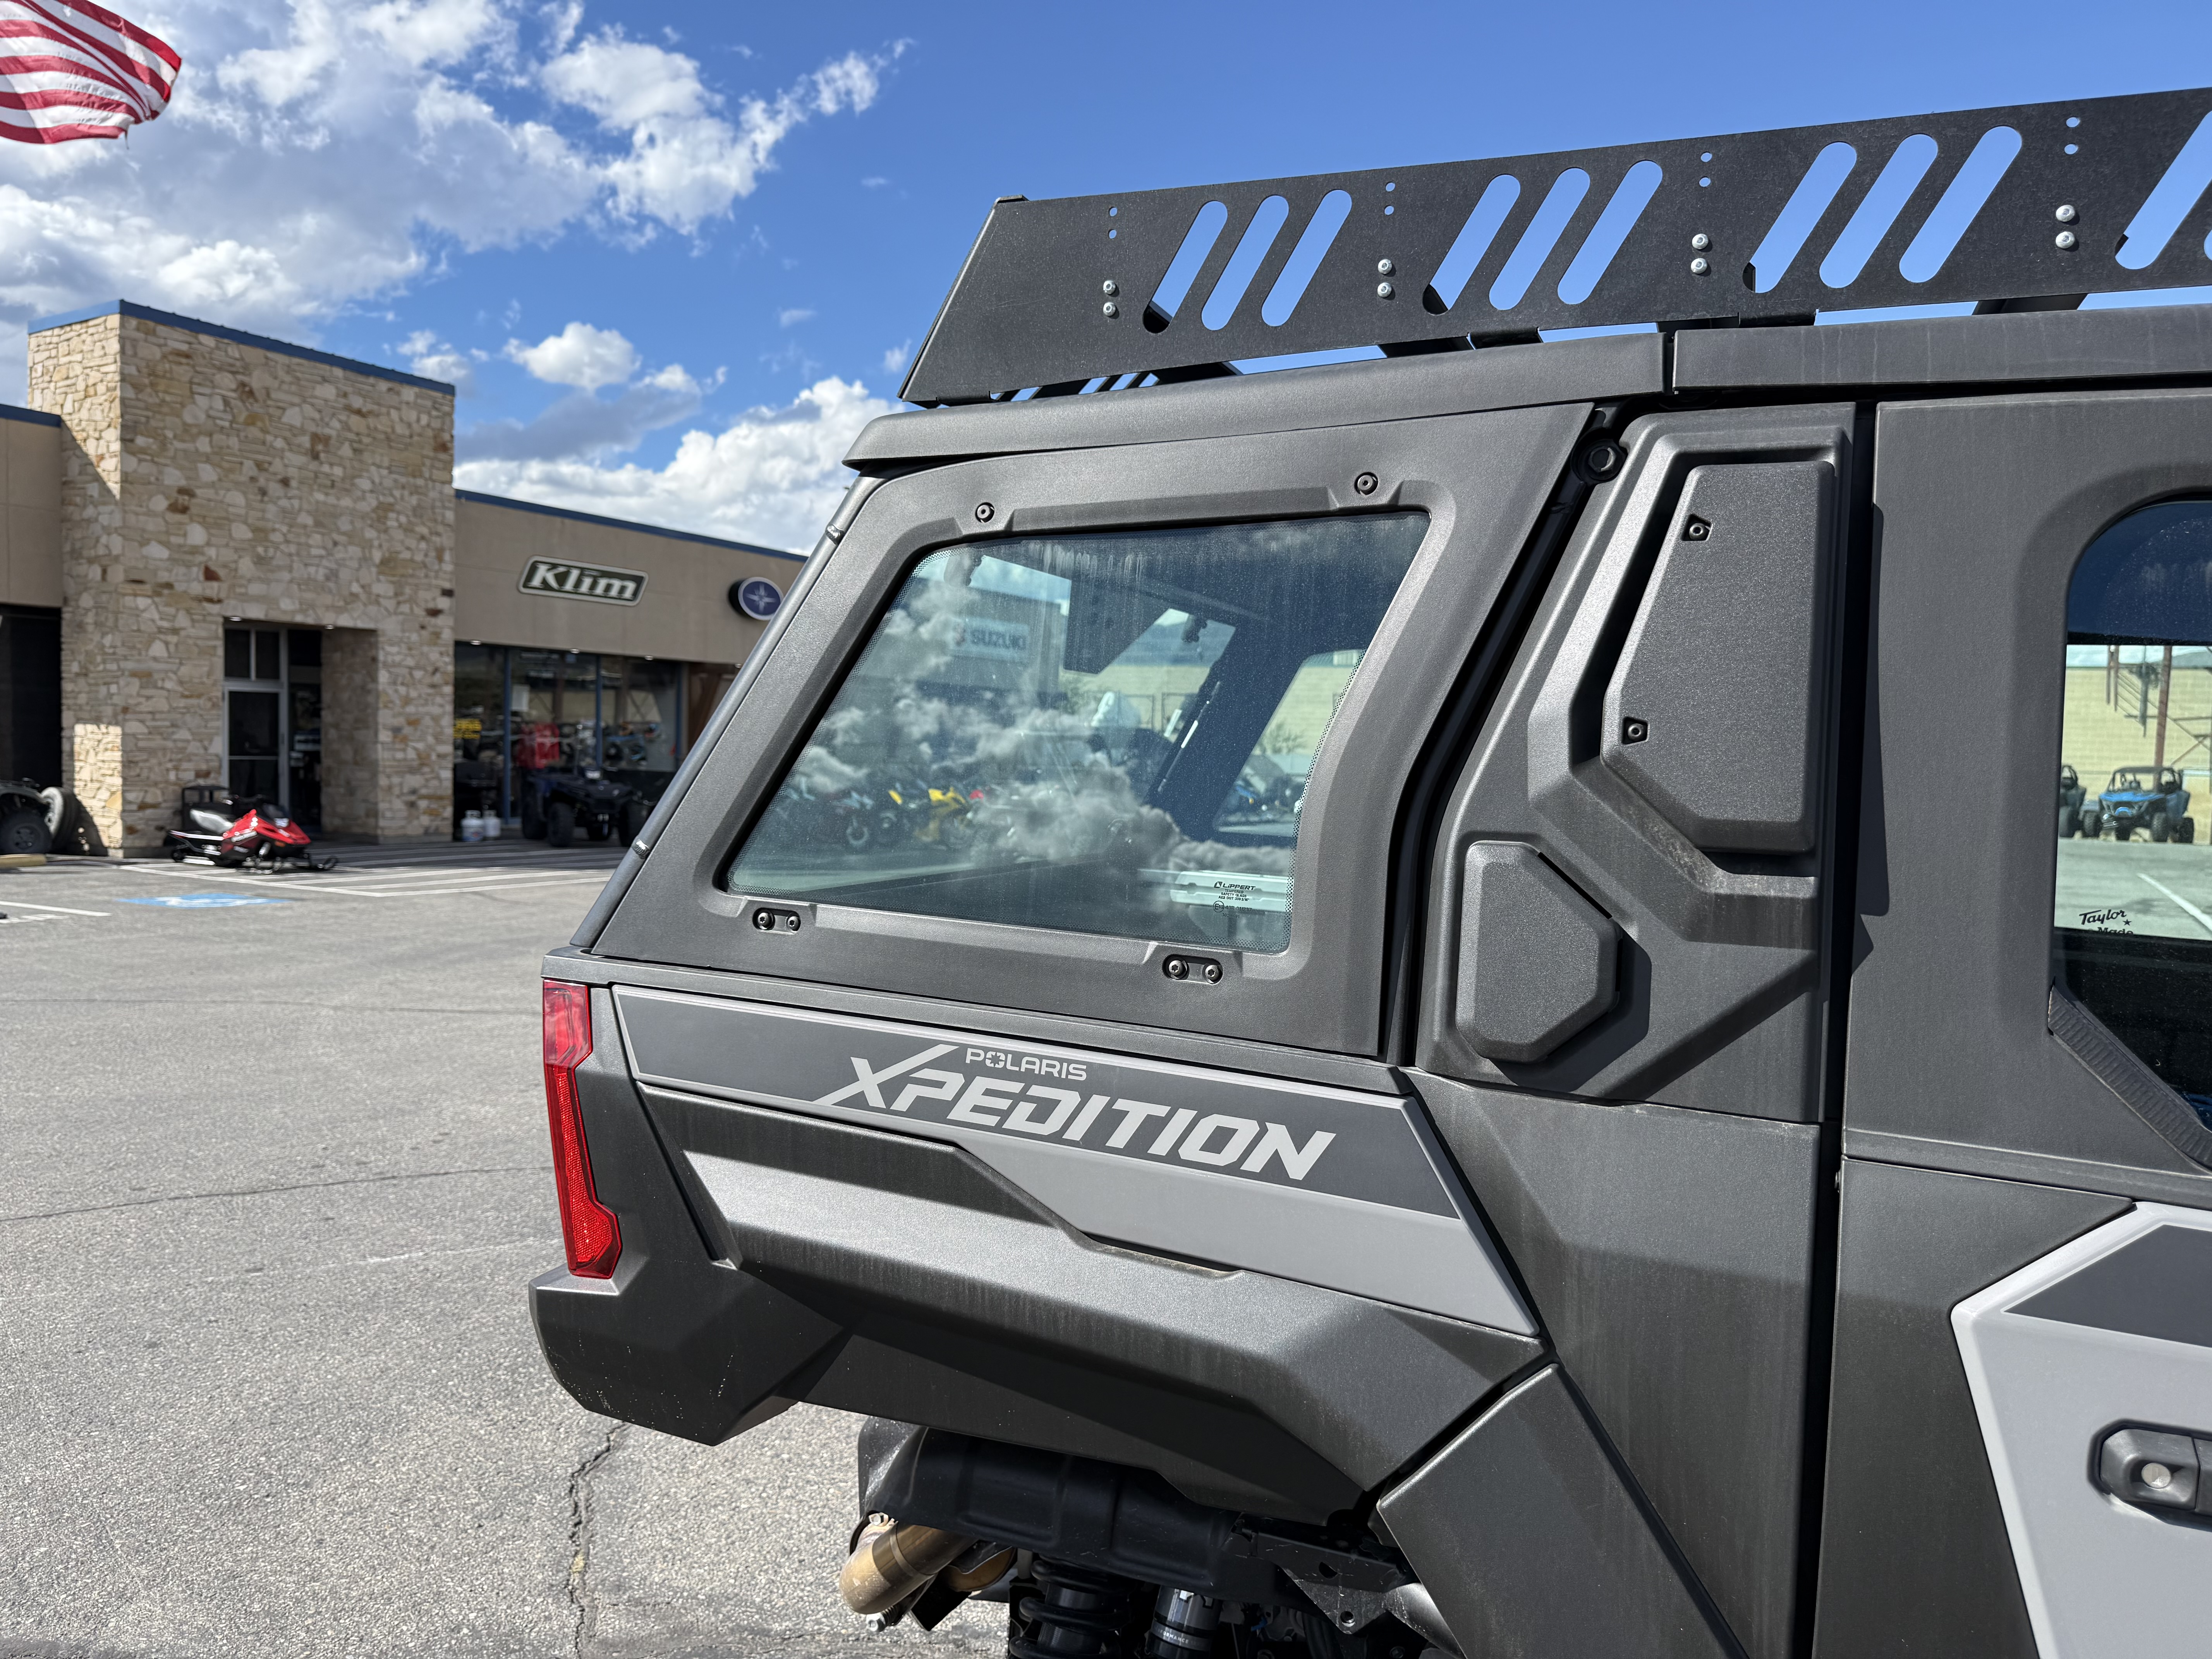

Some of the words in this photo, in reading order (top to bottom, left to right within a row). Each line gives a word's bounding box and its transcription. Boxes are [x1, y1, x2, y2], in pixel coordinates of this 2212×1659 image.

[527, 562, 636, 599] Klim
[2079, 909, 2127, 925] Taylor
[965, 1048, 1087, 1081] POLARIS
[812, 1044, 1337, 1181] XPEDITION
[1156, 1627, 1189, 1644] FORMANCE
